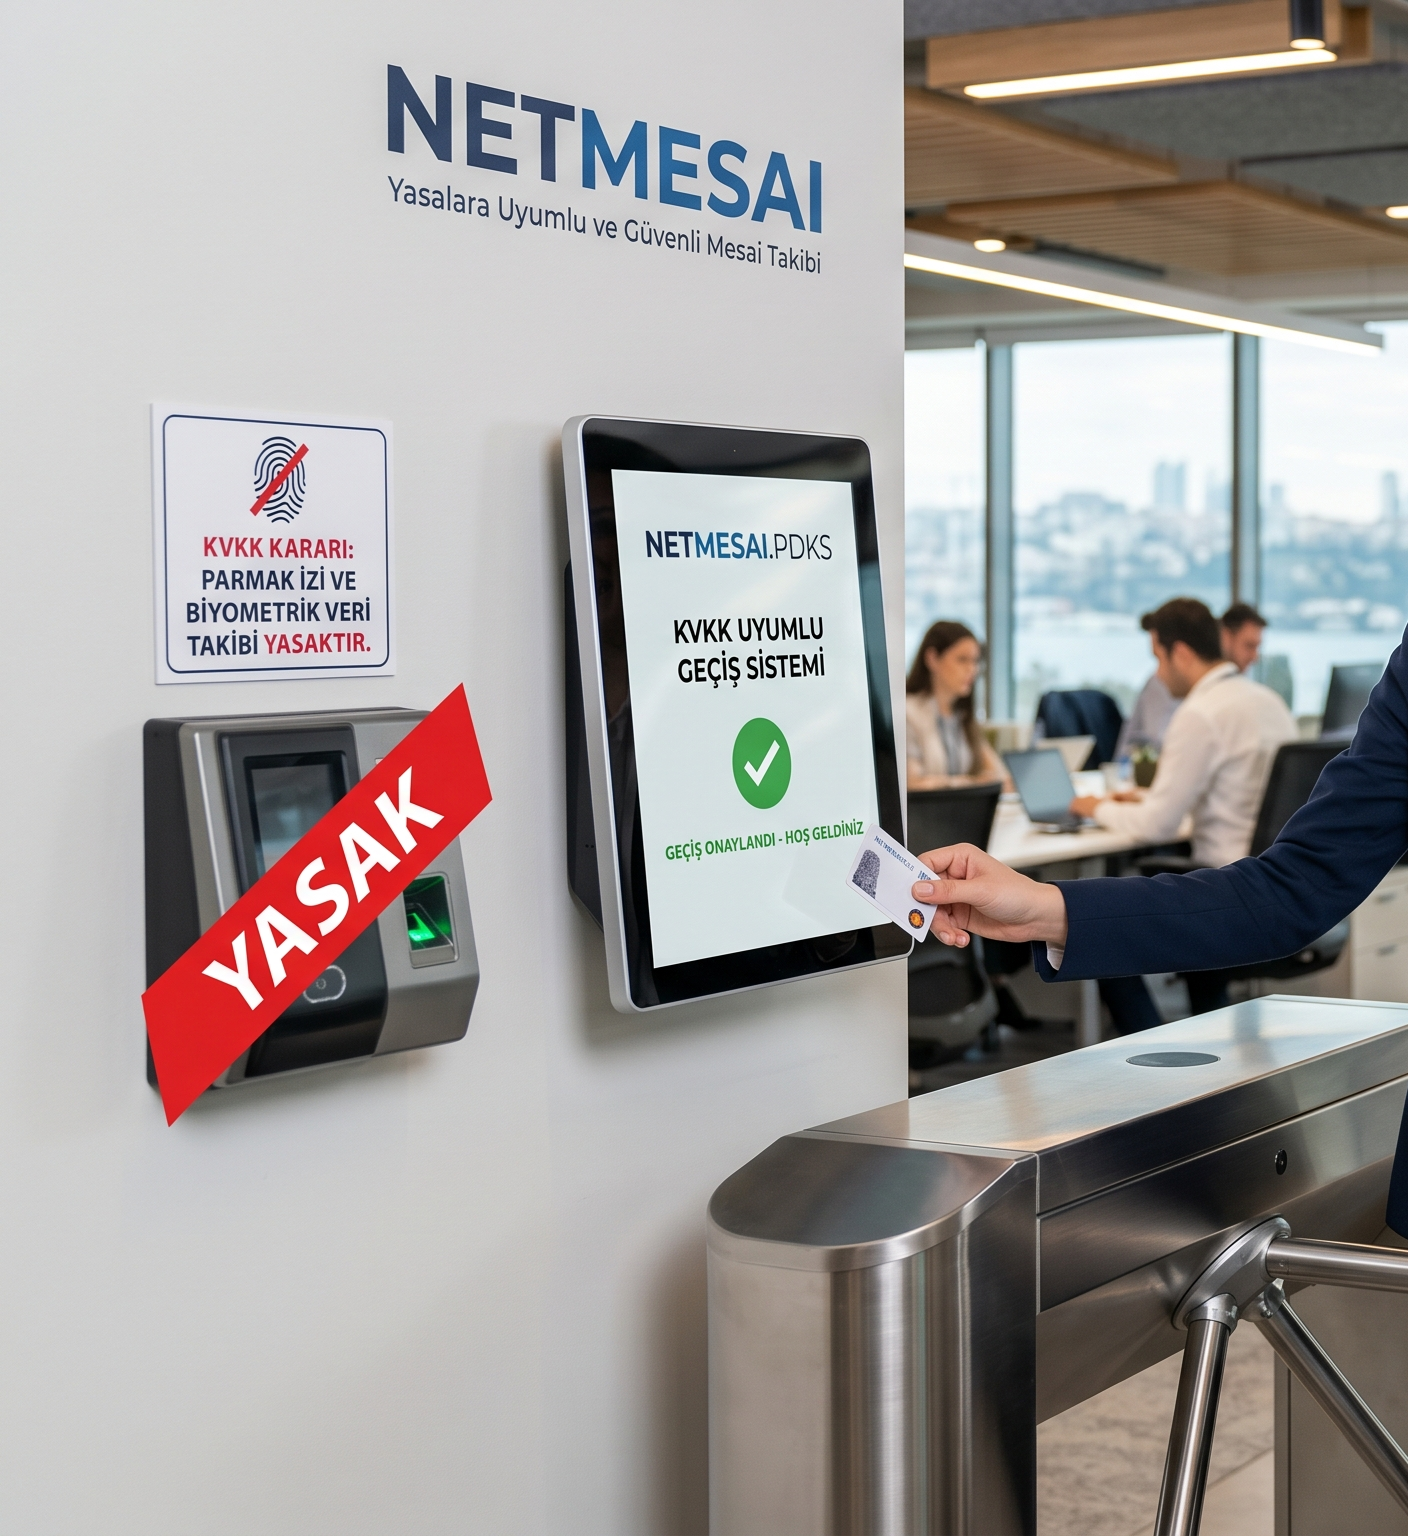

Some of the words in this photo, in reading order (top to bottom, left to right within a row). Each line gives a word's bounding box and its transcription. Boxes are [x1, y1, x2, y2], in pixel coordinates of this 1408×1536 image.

[387, 63, 822, 234] NETMESAI
[387, 175, 490, 218] Yasalara
[498, 196, 587, 235] Uyumlu
[593, 217, 618, 239] ve
[624, 219, 701, 254] Güvenli
[707, 233, 762, 265] Mesai
[767, 244, 822, 274] Takibi
[203, 536, 264, 558] KVKK
[269, 537, 354, 559] KARARI:
[645, 530, 833, 561] NETMESAI.PDKS
[202, 569, 295, 591] PARMAK
[300, 565, 325, 591] İZİ
[330, 570, 357, 591] VE
[186, 596, 321, 623] BİYOMETRİK
[324, 596, 371, 622] VERİ
[187, 629, 258, 656] TAKİBİ
[263, 632, 371, 655] YASAKTIR.
[673, 618, 734, 644] KVKK
[737, 616, 824, 643] UYUMLU
[677, 649, 741, 689] GEÇİŞ
[745, 646, 826, 681] SİSTEMİ
[665, 837, 703, 863] GEÇİŞ
[704, 832, 776, 856] ONAYLANDI
[785, 827, 811, 847] HOŞ
[812, 819, 865, 842] GELDİNİZ
[201, 766, 444, 1011] YASAK
